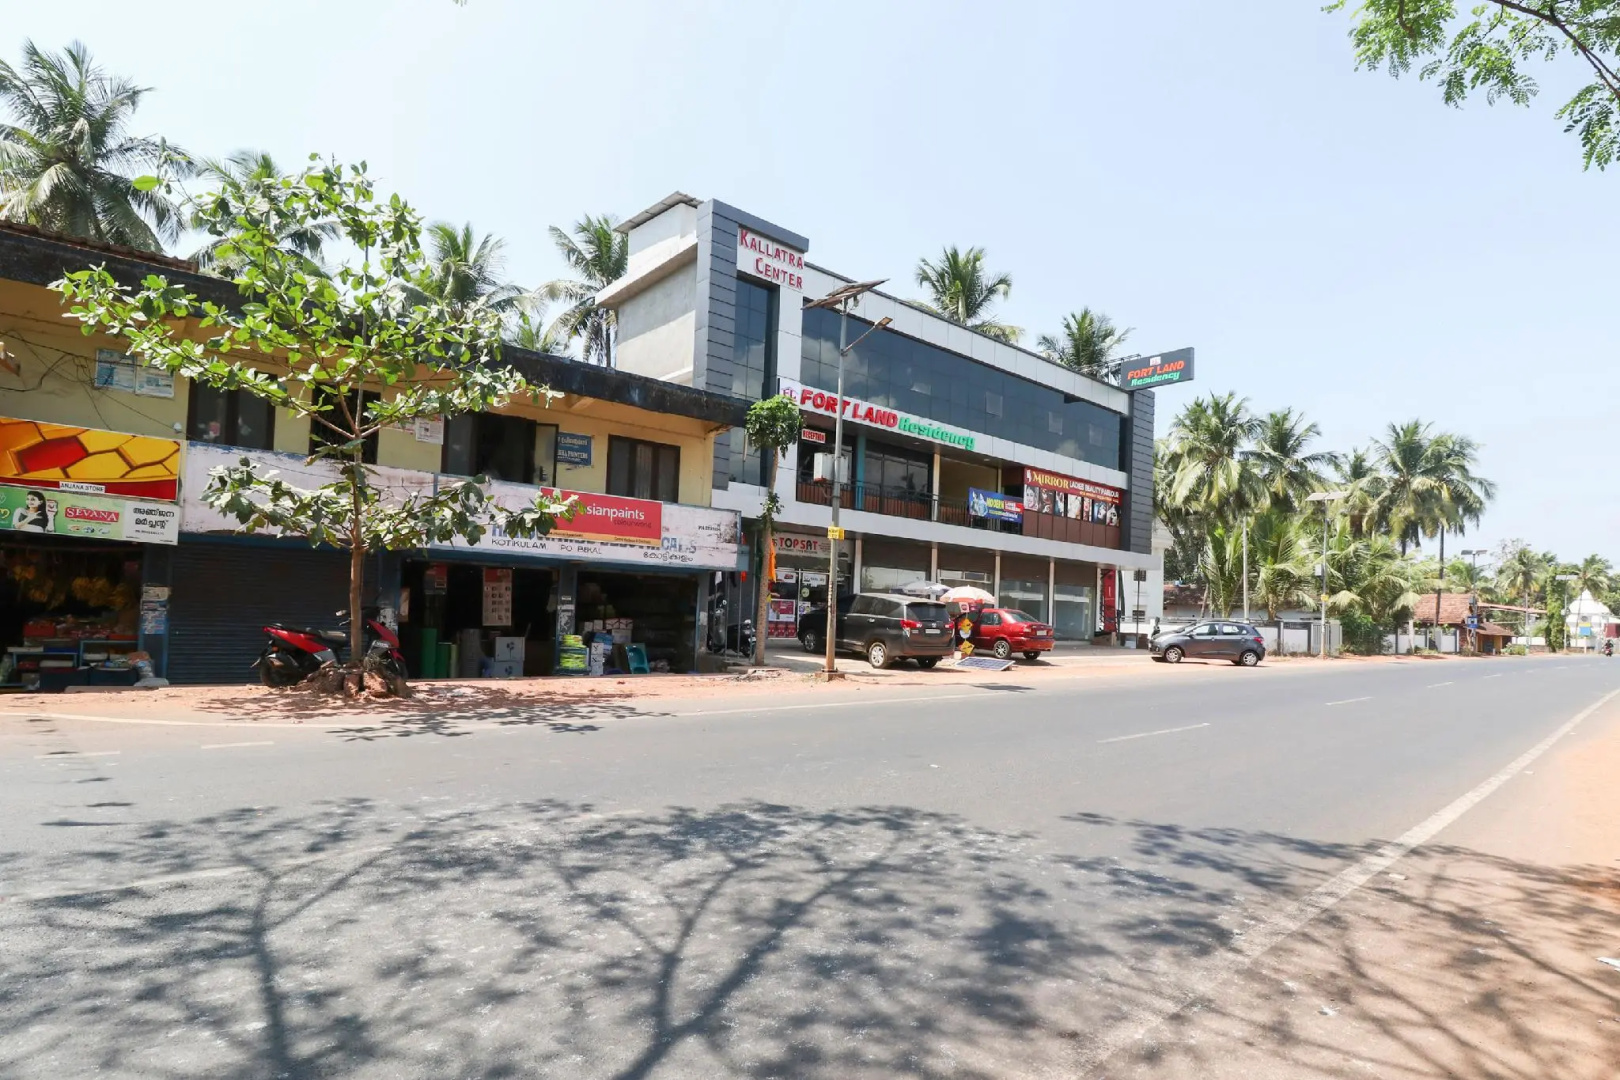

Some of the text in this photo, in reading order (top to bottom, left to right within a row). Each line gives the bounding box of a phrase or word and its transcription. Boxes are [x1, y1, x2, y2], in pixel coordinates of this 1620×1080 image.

[740, 228, 804, 270] KALLATRA
[755, 257, 803, 289] CENTER
[1127, 366, 1154, 380] FORT
[1156, 360, 1185, 374] LAND
[1130, 371, 1180, 386] Residency
[801, 389, 976, 450] FORT LAND Residency
[802, 429, 825, 443] RECEPTION
[1032, 471, 1070, 489] MIRROR
[66, 508, 117, 521] SEVANA
[576, 502, 645, 521] sianpaints
[491, 538, 547, 550] KOTIKULAM
[560, 544, 573, 552] PO
[577, 545, 602, 554] BEKAL
